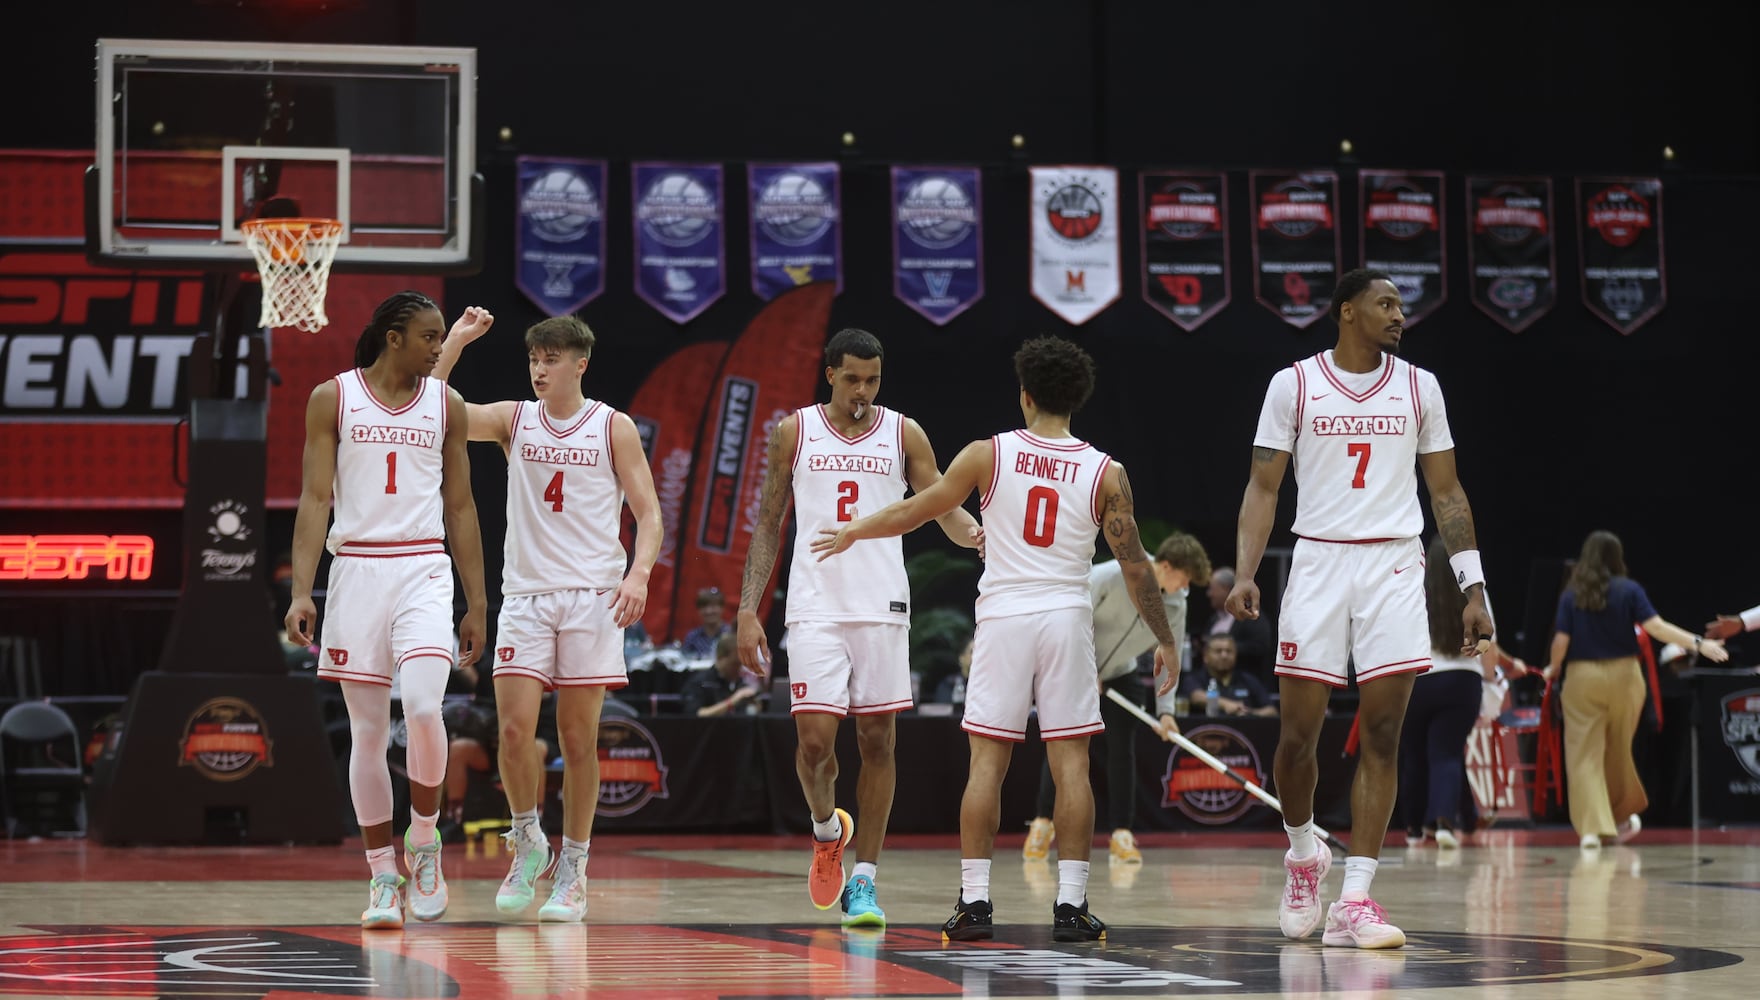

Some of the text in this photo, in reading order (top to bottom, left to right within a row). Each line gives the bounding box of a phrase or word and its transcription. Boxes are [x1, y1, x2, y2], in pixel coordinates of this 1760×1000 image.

[0, 335, 250, 409] ENT
[352, 425, 435, 448] DAYTON
[717, 383, 751, 475] EVENTS
[1313, 416, 1407, 435] DAYTON
[385, 451, 397, 494] 1
[522, 444, 599, 467] DAYTON
[809, 454, 892, 475] DAYTON
[1015, 451, 1081, 484] BENNETT
[1347, 443, 1371, 489] 7
[544, 471, 564, 513] 4
[837, 480, 859, 522] 2
[1023, 485, 1059, 548] 0
[0, 534, 154, 581] ESPN
